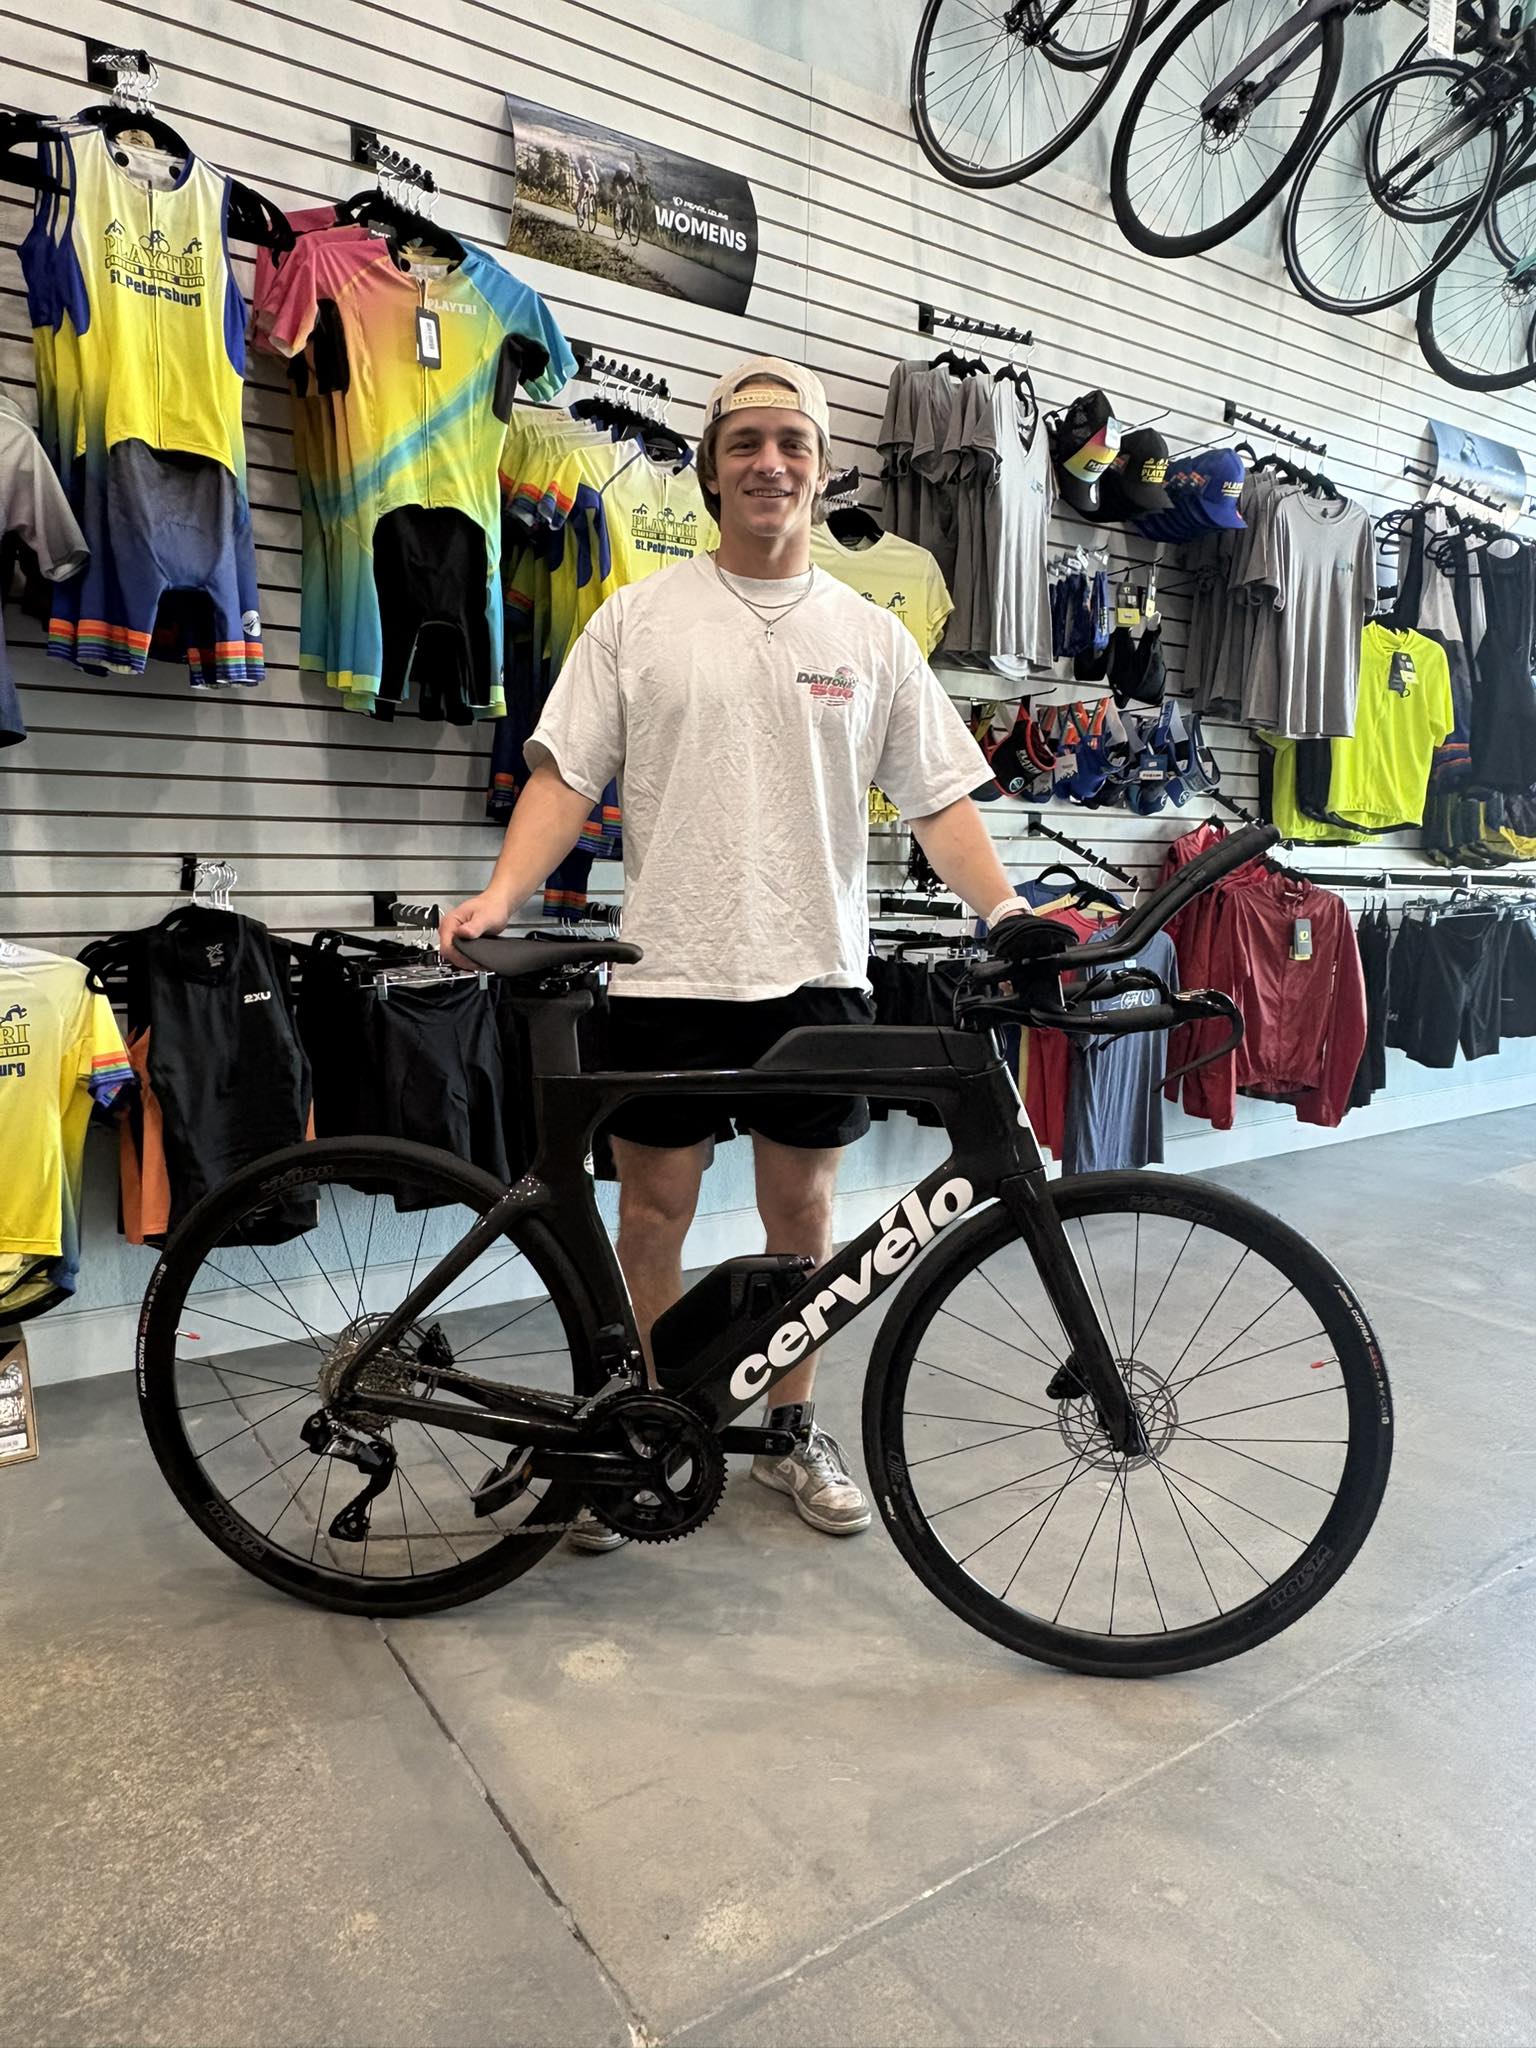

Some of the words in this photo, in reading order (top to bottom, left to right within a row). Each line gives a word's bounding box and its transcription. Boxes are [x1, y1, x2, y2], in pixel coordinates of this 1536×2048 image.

[654, 204, 747, 252] WOMENS
[104, 234, 203, 276] PLAYTRI
[243, 990, 272, 1004] 2XU
[729, 1177, 974, 1400] cervélo
